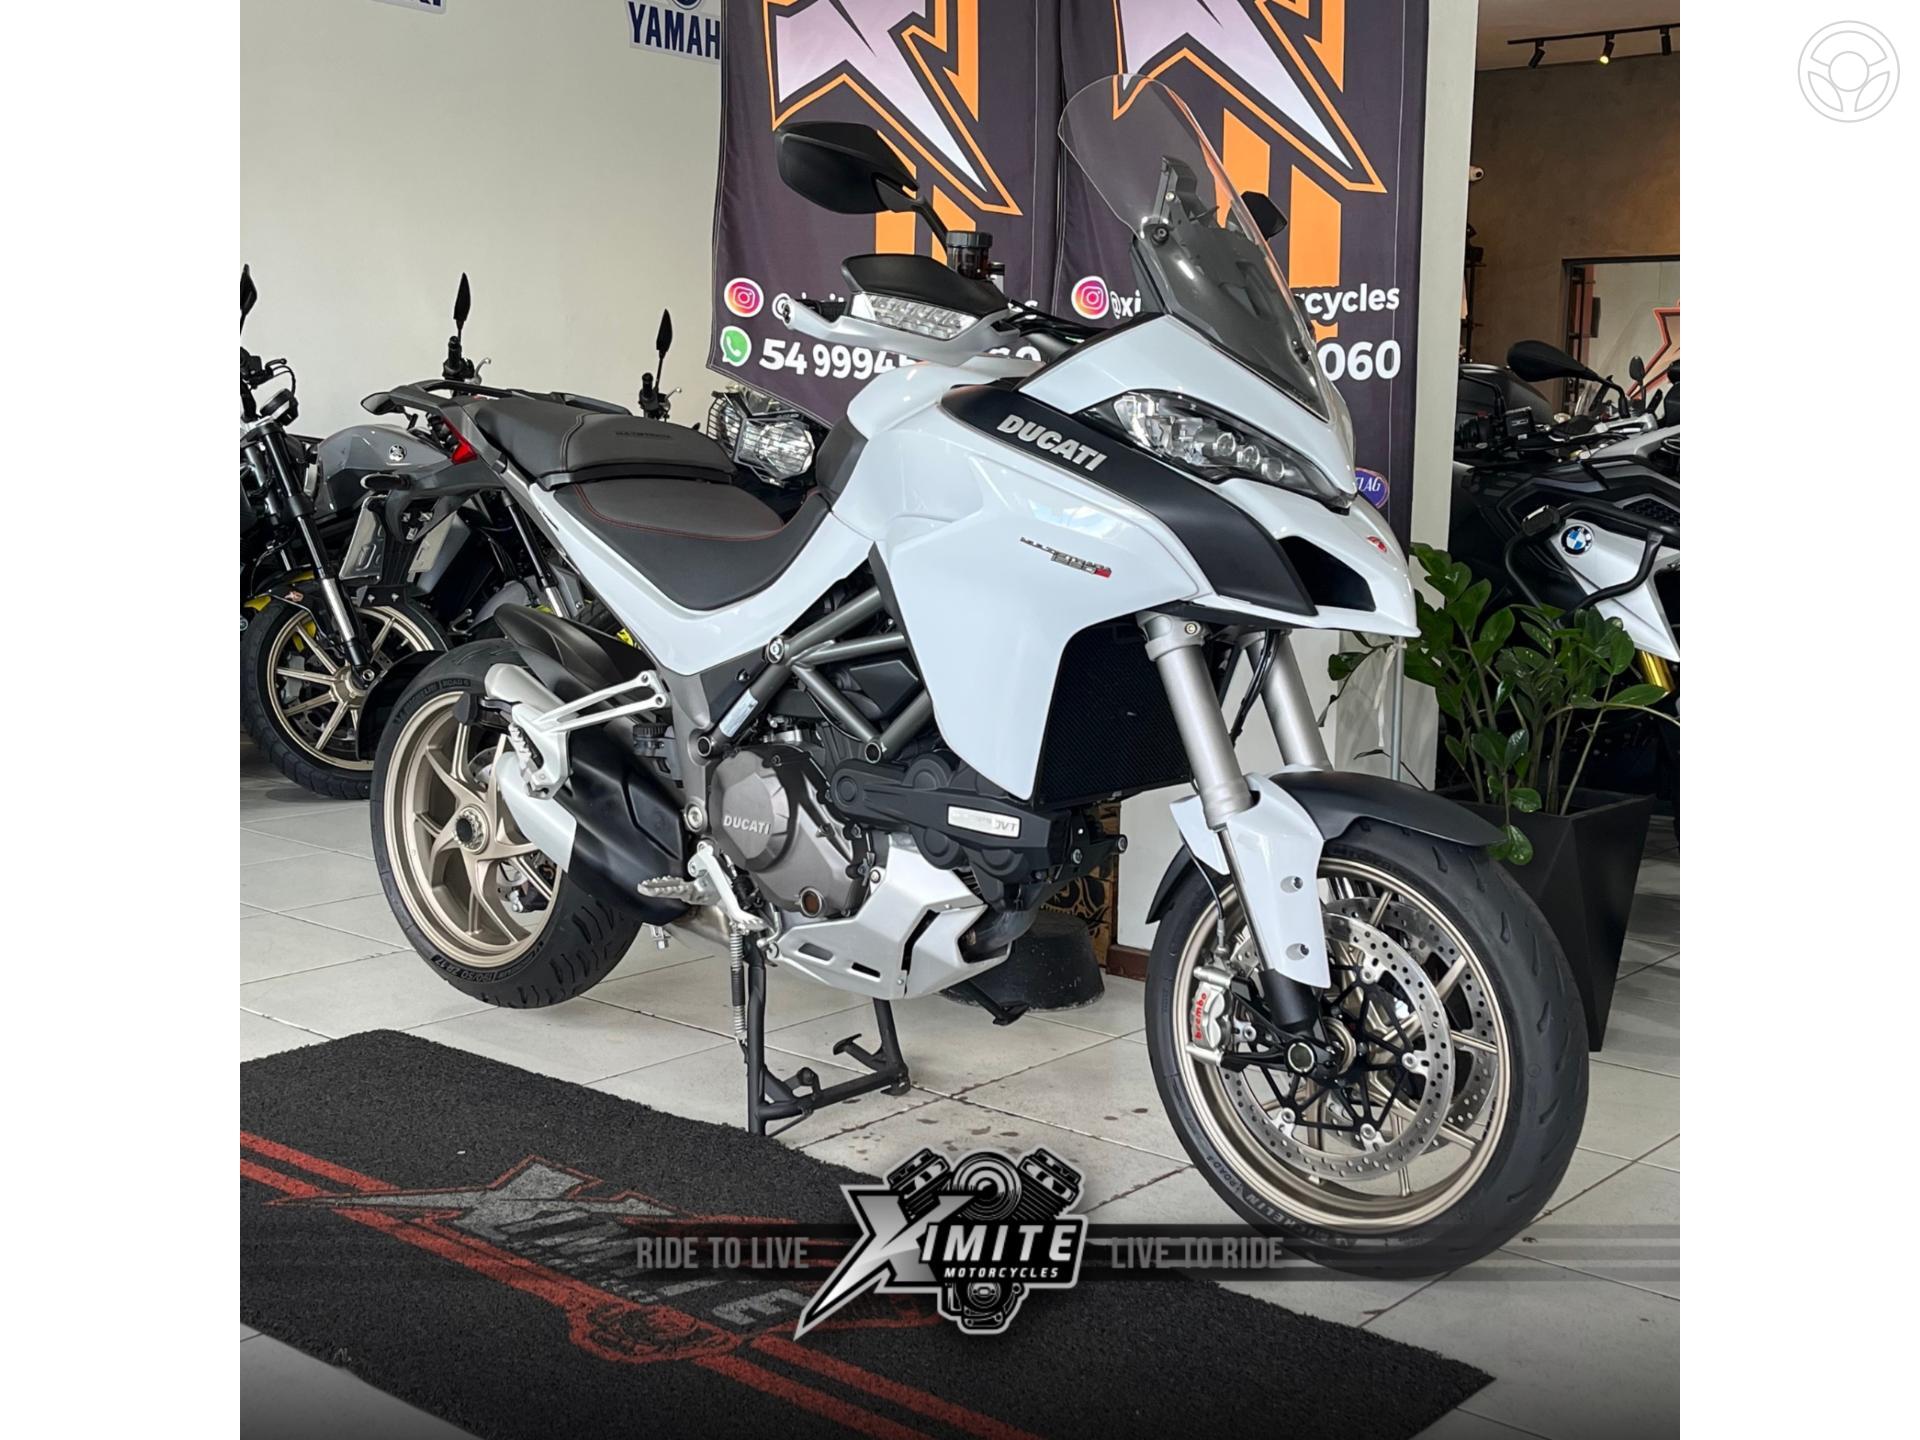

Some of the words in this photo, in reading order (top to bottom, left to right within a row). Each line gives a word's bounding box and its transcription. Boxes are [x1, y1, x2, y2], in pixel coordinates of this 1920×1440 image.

[628, 1, 720, 60] YAMAH
[1297, 283, 1400, 321] cycles
[759, 338, 807, 376] 54
[997, 414, 1108, 472] DUCATI
[1356, 476, 1382, 492] LAG
[723, 814, 771, 835] DUCATI
[1194, 991, 1207, 1041] brembo
